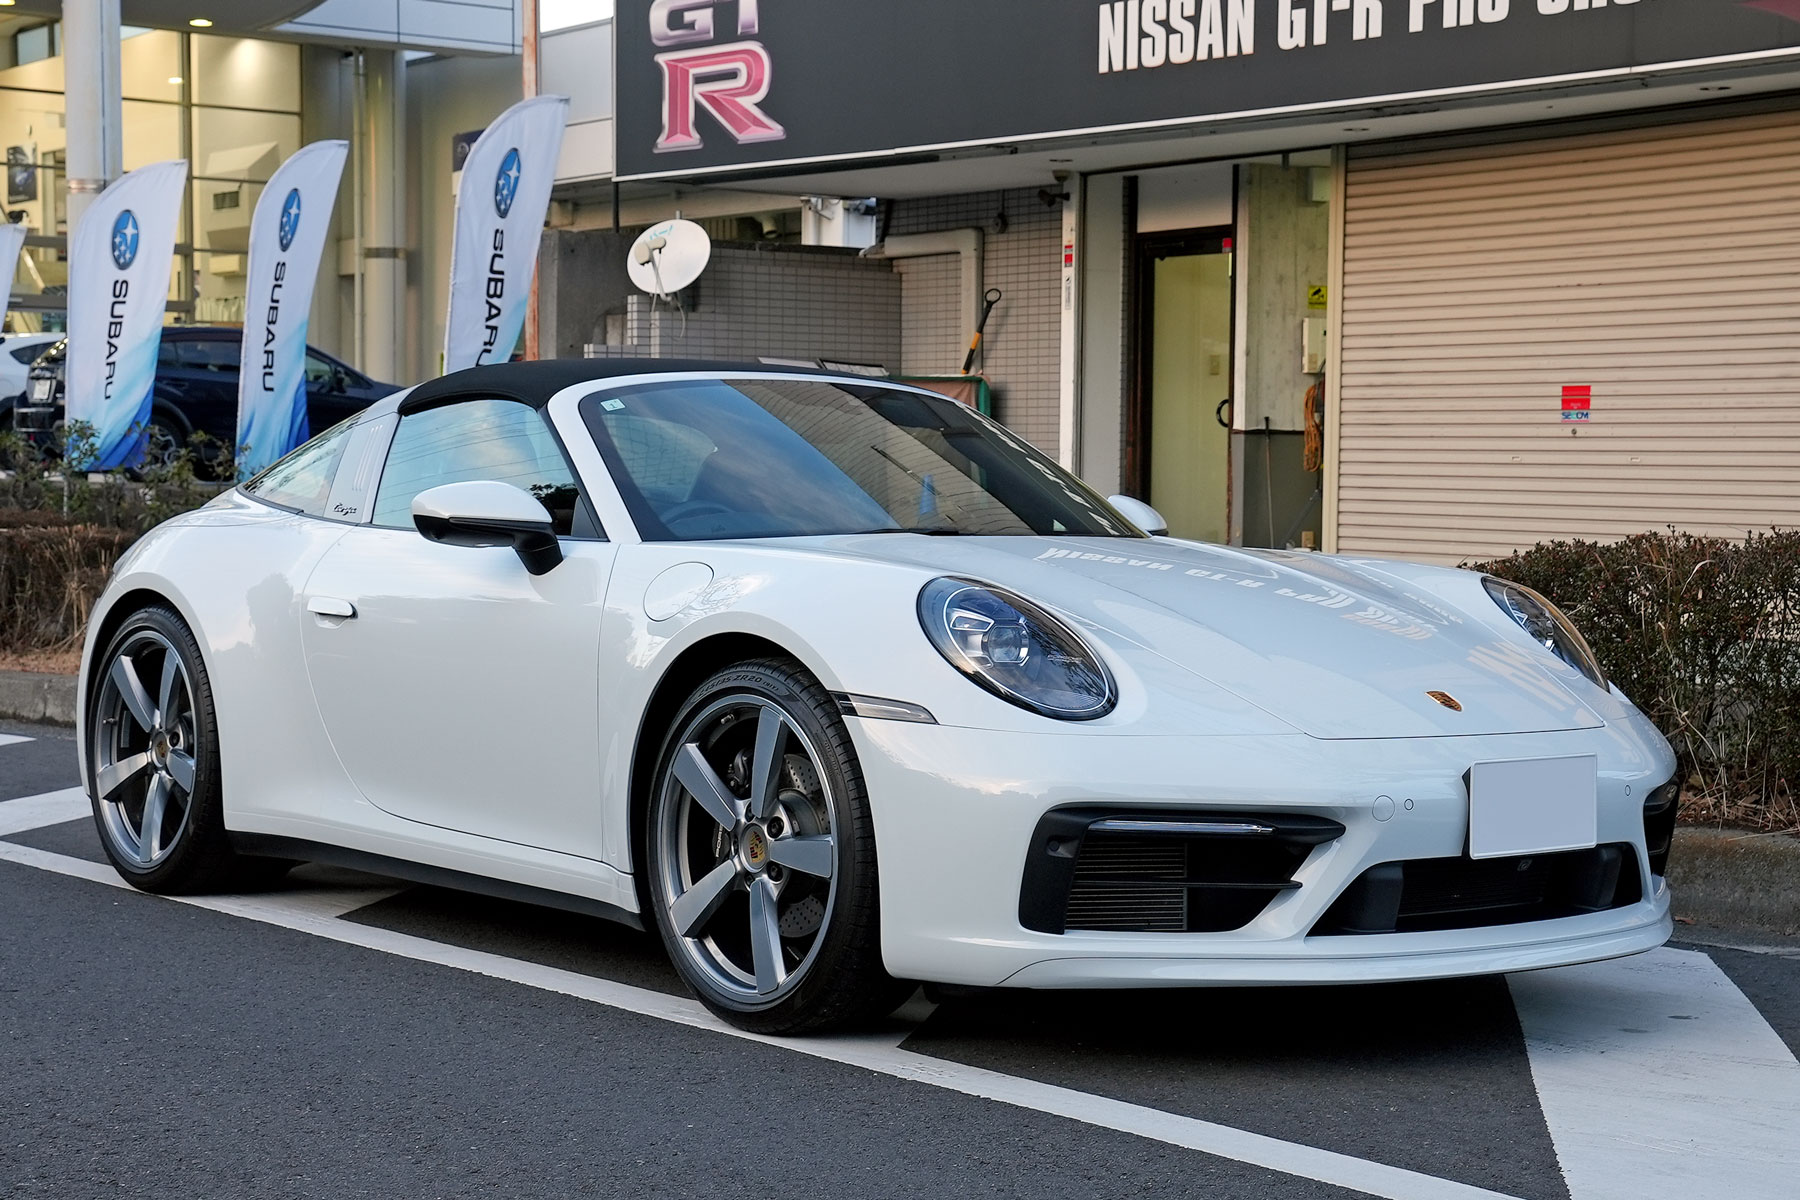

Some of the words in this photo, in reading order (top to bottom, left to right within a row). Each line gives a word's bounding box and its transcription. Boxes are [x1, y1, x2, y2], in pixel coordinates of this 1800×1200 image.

[1099, 0, 1254, 74] NISSAN
[653, 40, 786, 153] R
[104, 280, 129, 400] SUBARU
[262, 262, 286, 392] SUBARU
[475, 228, 505, 367] SUBARU
[734, 674, 763, 683] ZR20
